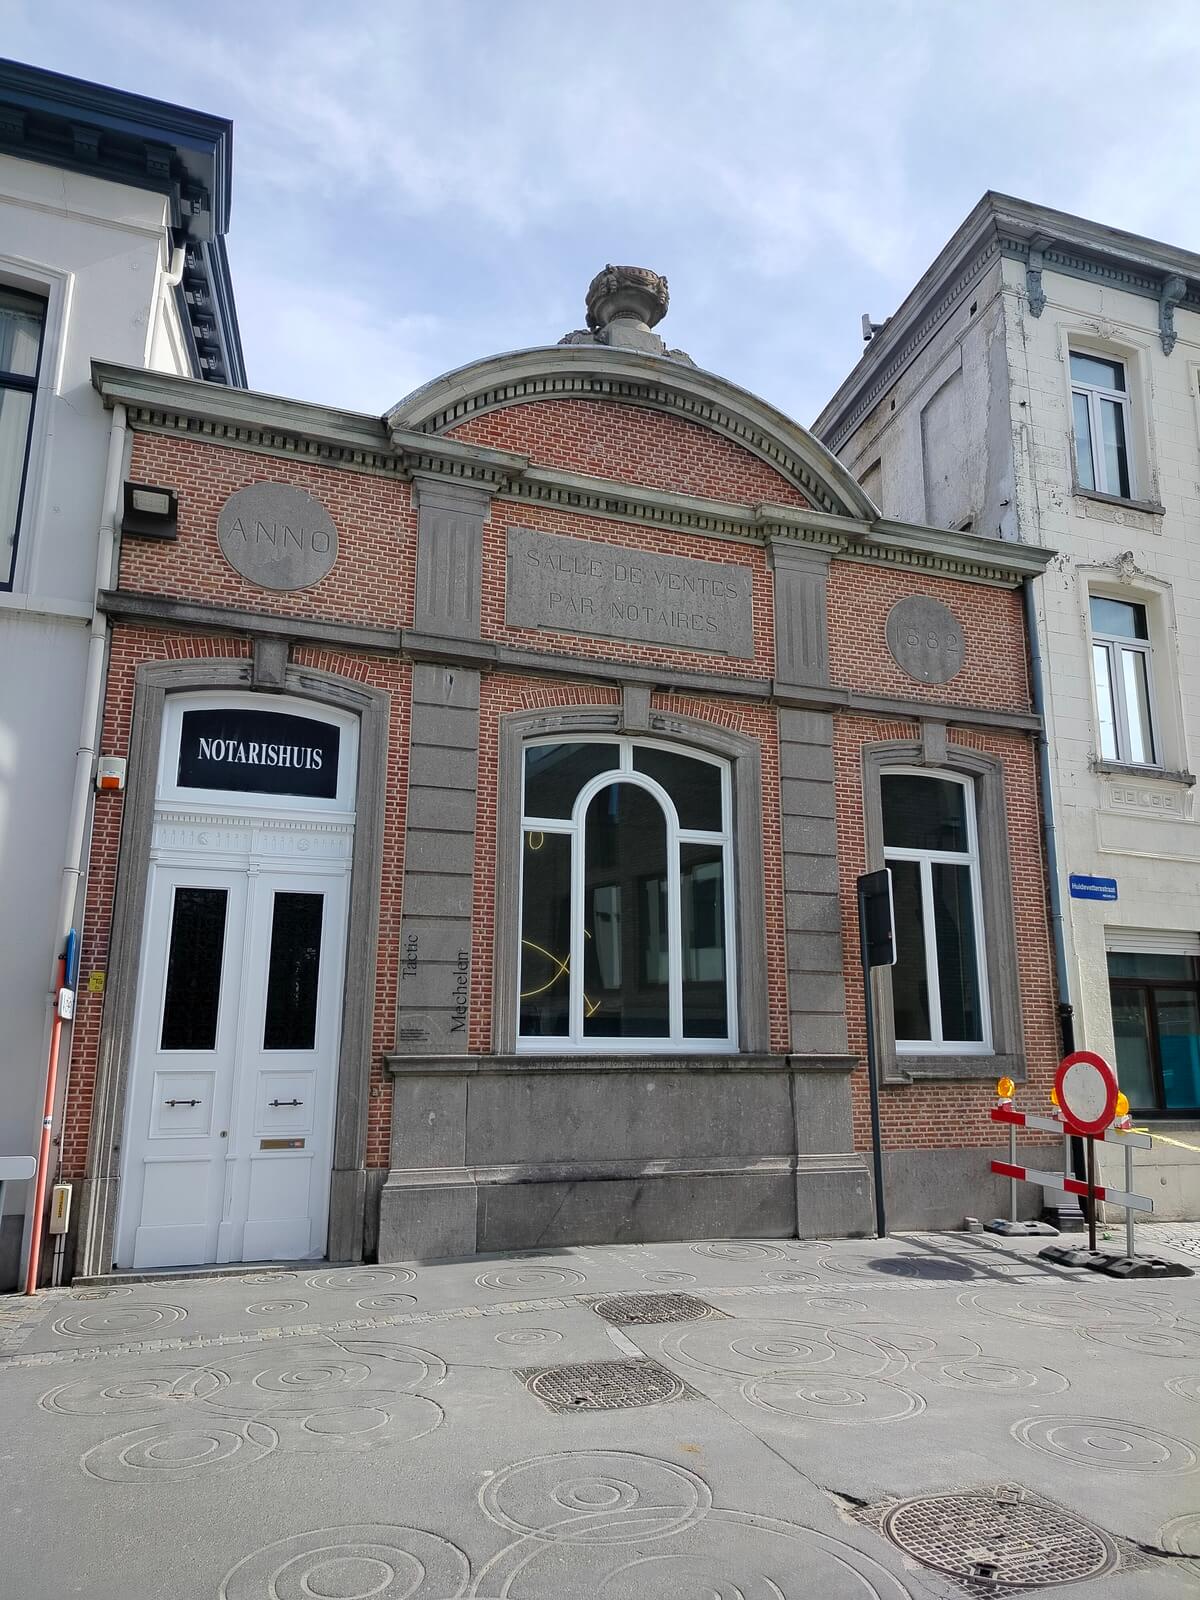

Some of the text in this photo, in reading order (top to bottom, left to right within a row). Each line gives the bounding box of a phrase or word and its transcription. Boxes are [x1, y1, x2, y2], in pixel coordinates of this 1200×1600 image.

[227, 517, 330, 553] ANNO
[526, 549, 738, 599] SALLE DE VENTES
[549, 592, 718, 633] PAR NOTAIRES
[895, 624, 959, 653] 1882
[198, 737, 323, 770] NOTARISHUIS
[402, 934, 419, 980] Tactic
[450, 951, 469, 1034] Mechelen
